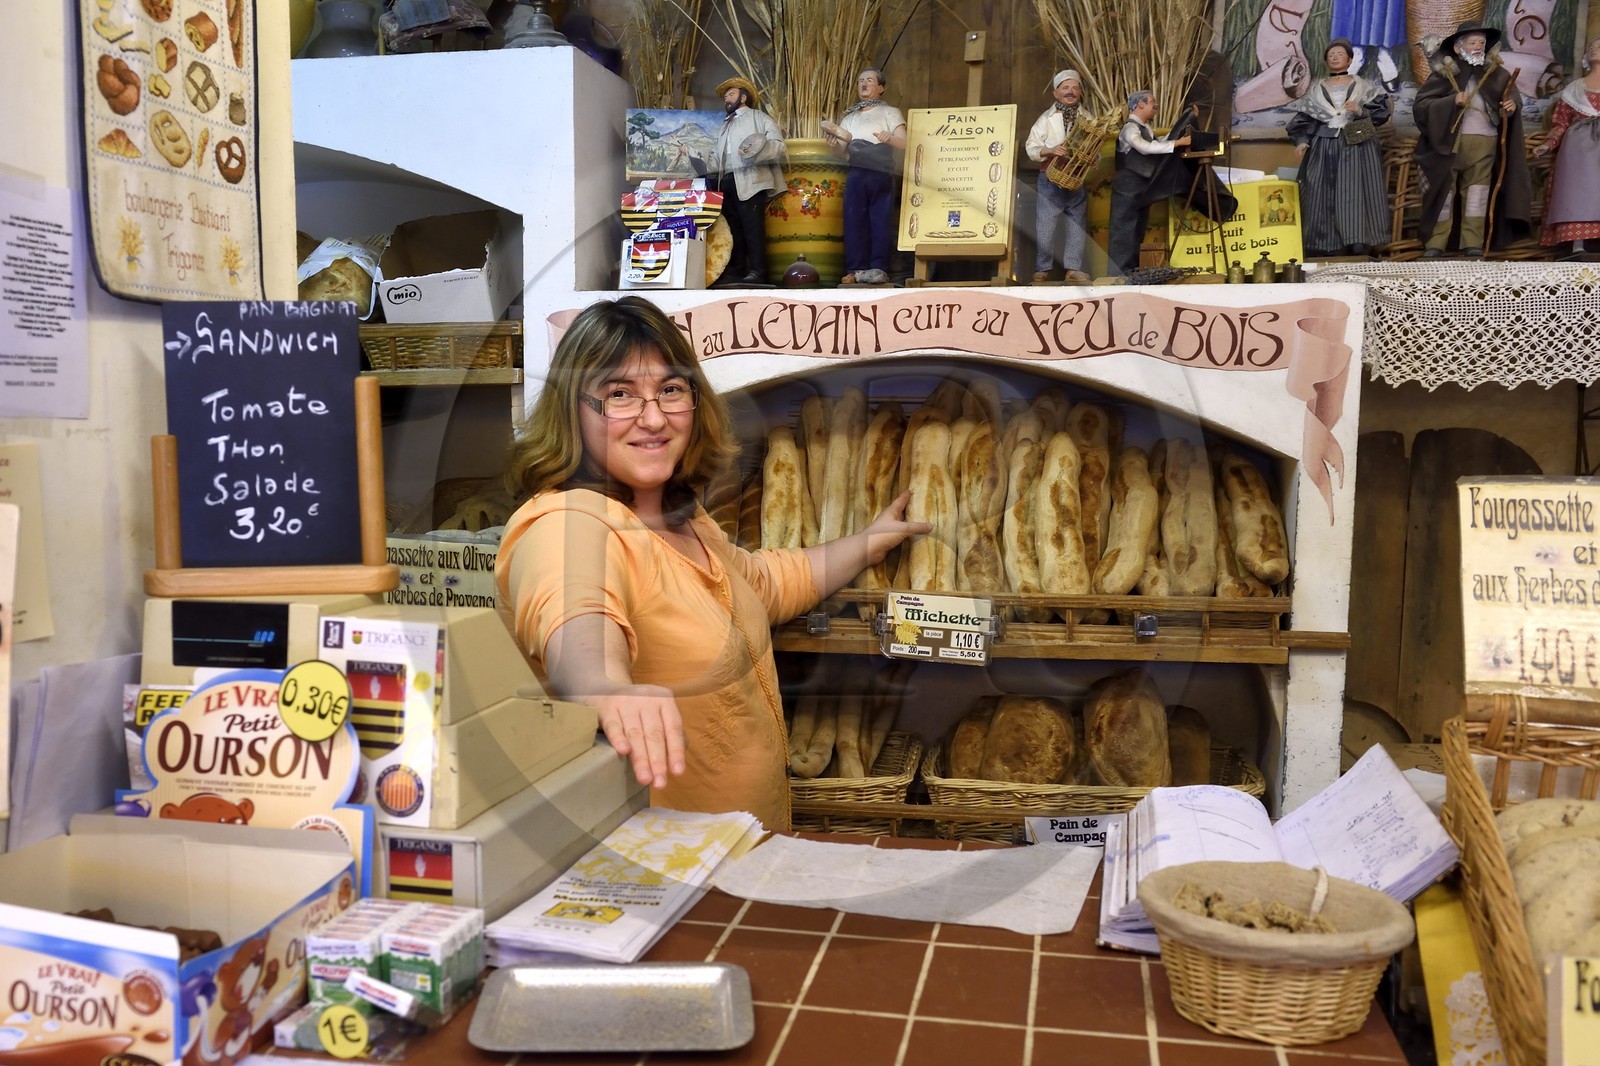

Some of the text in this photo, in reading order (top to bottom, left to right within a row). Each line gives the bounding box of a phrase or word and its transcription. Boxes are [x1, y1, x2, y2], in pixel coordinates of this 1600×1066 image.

[947, 114, 977, 124] PAIN
[927, 124, 995, 137] MAISON
[1186, 246, 1203, 255] au
[1230, 241, 1247, 252] de
[1250, 236, 1279, 249] bois
[393, 289, 417, 300] mio
[239, 301, 358, 320] PAN BAGNAT
[191, 312, 338, 364] SANDWICH
[703, 331, 725, 356] au
[727, 301, 882, 355] LEVAIN
[1020, 297, 1117, 355] FEU
[1127, 312, 1159, 350] de
[1161, 306, 1284, 368] BOIS
[201, 385, 330, 424] Tomate
[204, 471, 321, 506] Salade
[1468, 486, 1595, 541] Fougassette
[437, 549, 461, 570] aux
[1572, 541, 1598, 565] et
[419, 571, 435, 585] et
[1472, 573, 1509, 602] aux
[428, 587, 444, 606] de
[905, 608, 980, 626] Michette
[955, 632, 981, 649] 1,10 €
[960, 650, 976, 658] 5,50
[140, 694, 191, 708] FEE
[203, 685, 280, 716] LE VRA
[281, 678, 349, 726] 0,30€
[223, 713, 282, 734] Petit
[157, 719, 335, 780] OURSON
[1049, 817, 1099, 830] Pain de
[1054, 831, 1107, 844] Campag
[38, 966, 53, 979] LE
[8, 979, 120, 1030] OURSON
